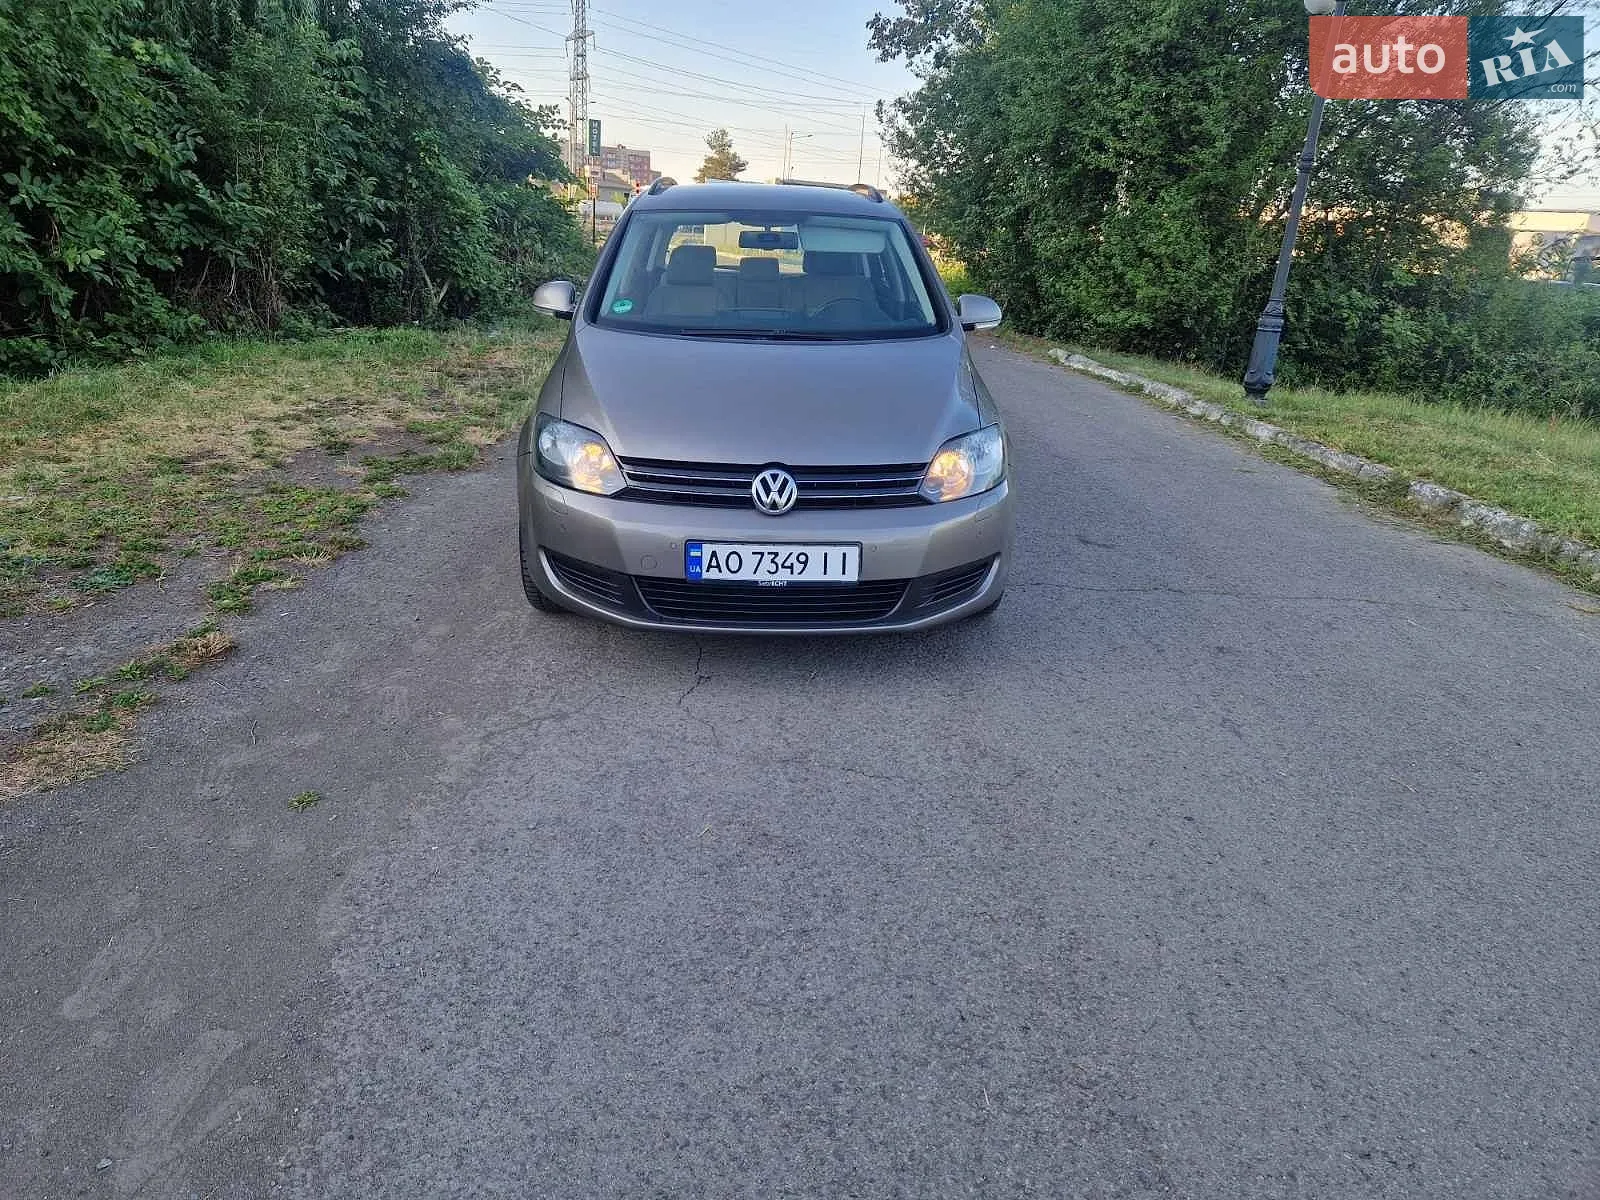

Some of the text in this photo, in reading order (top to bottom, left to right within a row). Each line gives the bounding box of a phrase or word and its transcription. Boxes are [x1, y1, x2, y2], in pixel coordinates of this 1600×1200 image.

[690, 565, 701, 573] UA
[705, 550, 743, 574] AO
[751, 551, 809, 576] 7349
